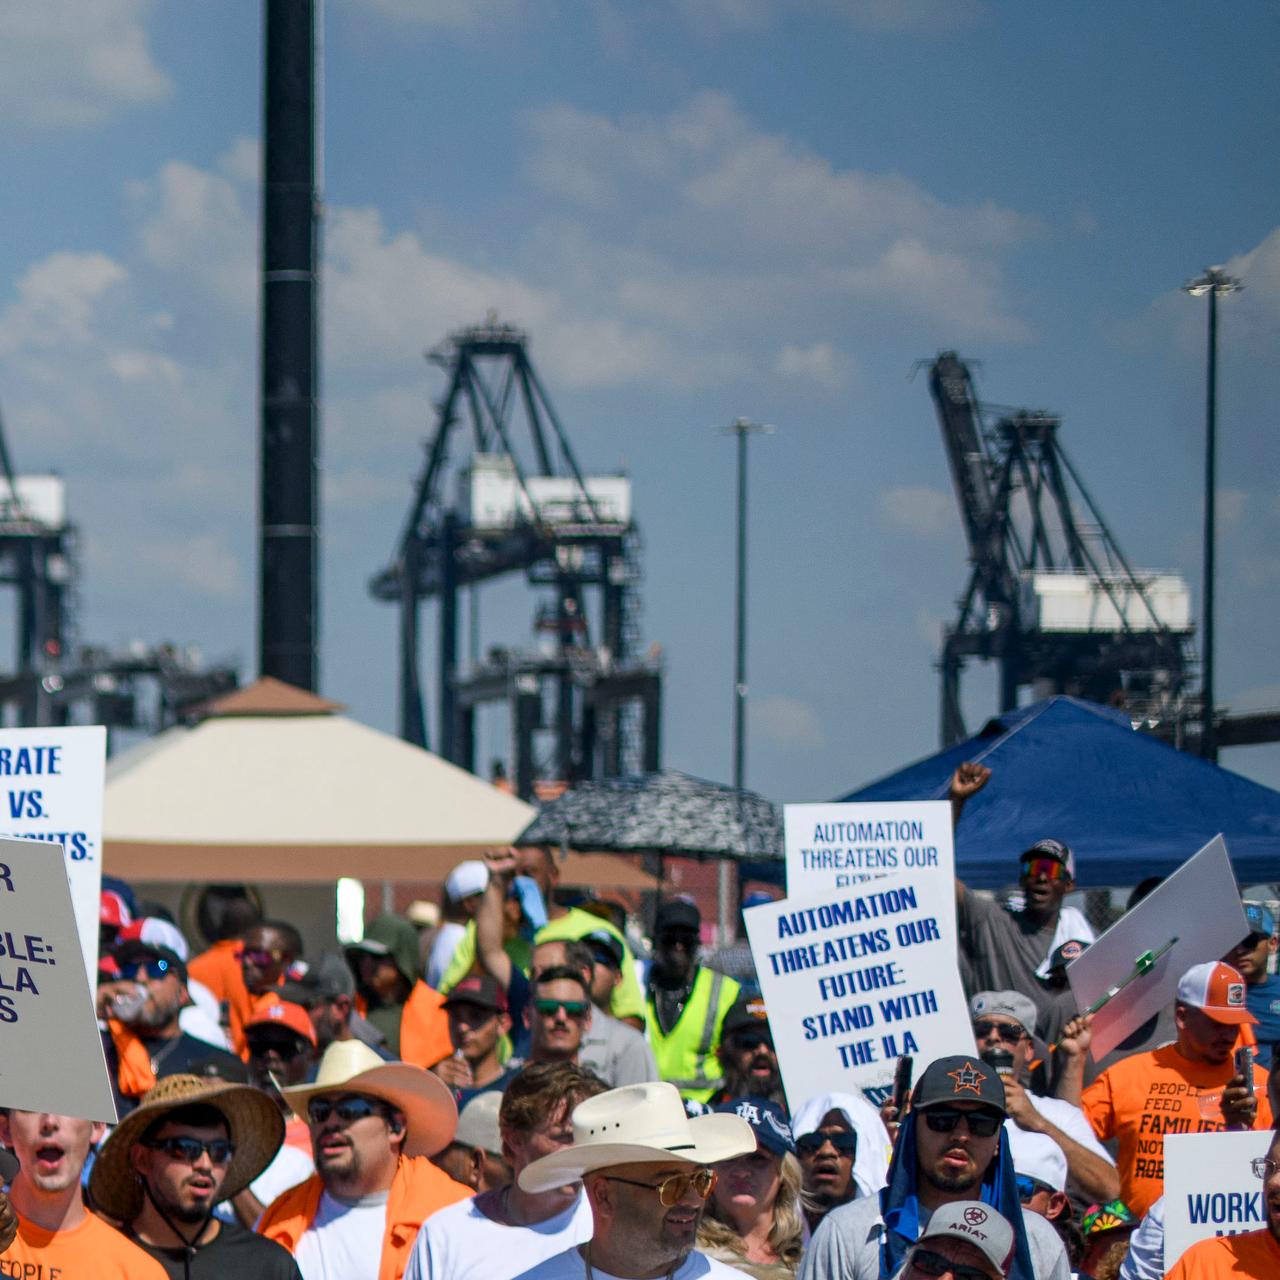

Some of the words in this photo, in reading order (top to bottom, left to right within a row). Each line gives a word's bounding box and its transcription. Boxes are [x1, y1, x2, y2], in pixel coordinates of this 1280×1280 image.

[8, 789, 49, 819] VS.
[813, 820, 923, 844] AUTOMATION
[800, 847, 899, 869] THREATENS
[905, 846, 939, 867] OUR
[776, 886, 918, 940] AUTOMATION
[769, 930, 891, 976] THREATENS
[896, 917, 940, 946] OUR
[818, 961, 907, 1002] FUTURE:
[802, 1003, 874, 1042] STAND
[882, 989, 939, 1024] WITH
[837, 1041, 878, 1070] THE
[881, 1031, 919, 1062] ILA
[1144, 1098, 1182, 1112] FEED
[1187, 1191, 1268, 1225] WORK
[948, 1222, 988, 1241] ARIAT
